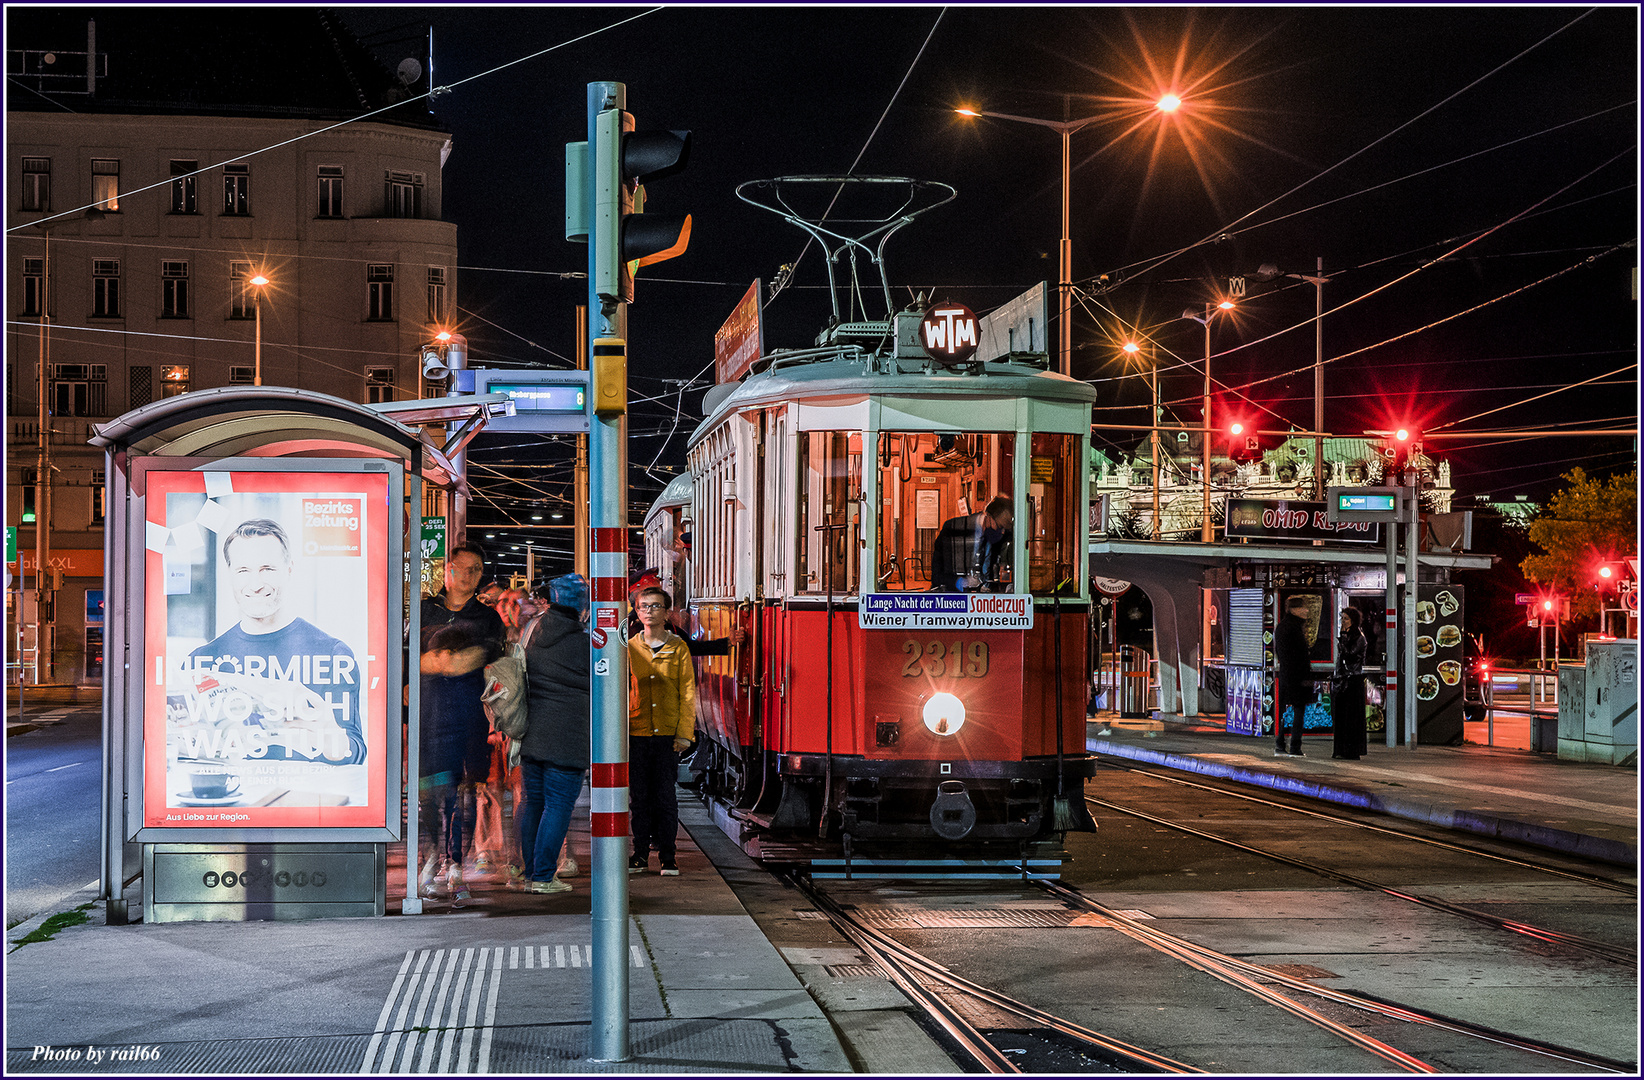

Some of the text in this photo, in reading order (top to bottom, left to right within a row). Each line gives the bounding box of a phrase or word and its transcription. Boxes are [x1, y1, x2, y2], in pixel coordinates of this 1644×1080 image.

[1230, 279, 1244, 295] W
[924, 309, 977, 354] WTM
[576, 391, 584, 405] 8
[304, 501, 354, 514] Bezirks
[305, 514, 359, 531] Zeitung
[1262, 509, 1309, 529] OMID
[1099, 581, 1128, 592] HALTESTELLE
[868, 595, 1025, 616] Lange Nacht der Museen Sonderzug
[863, 613, 1029, 628] Wiener Tramwaymuseum
[902, 639, 990, 678] 2319
[186, 691, 254, 722] WO
[264, 691, 350, 722] SICH
[182, 728, 269, 759] WAS
[255, 766, 276, 774] AUS
[278, 766, 300, 774] DEM
[302, 765, 336, 774] BEZIRK
[247, 776, 276, 785] EINEN
[166, 813, 182, 821] Aus
[183, 813, 205, 821] Liebe
[220, 813, 251, 822] Region.
